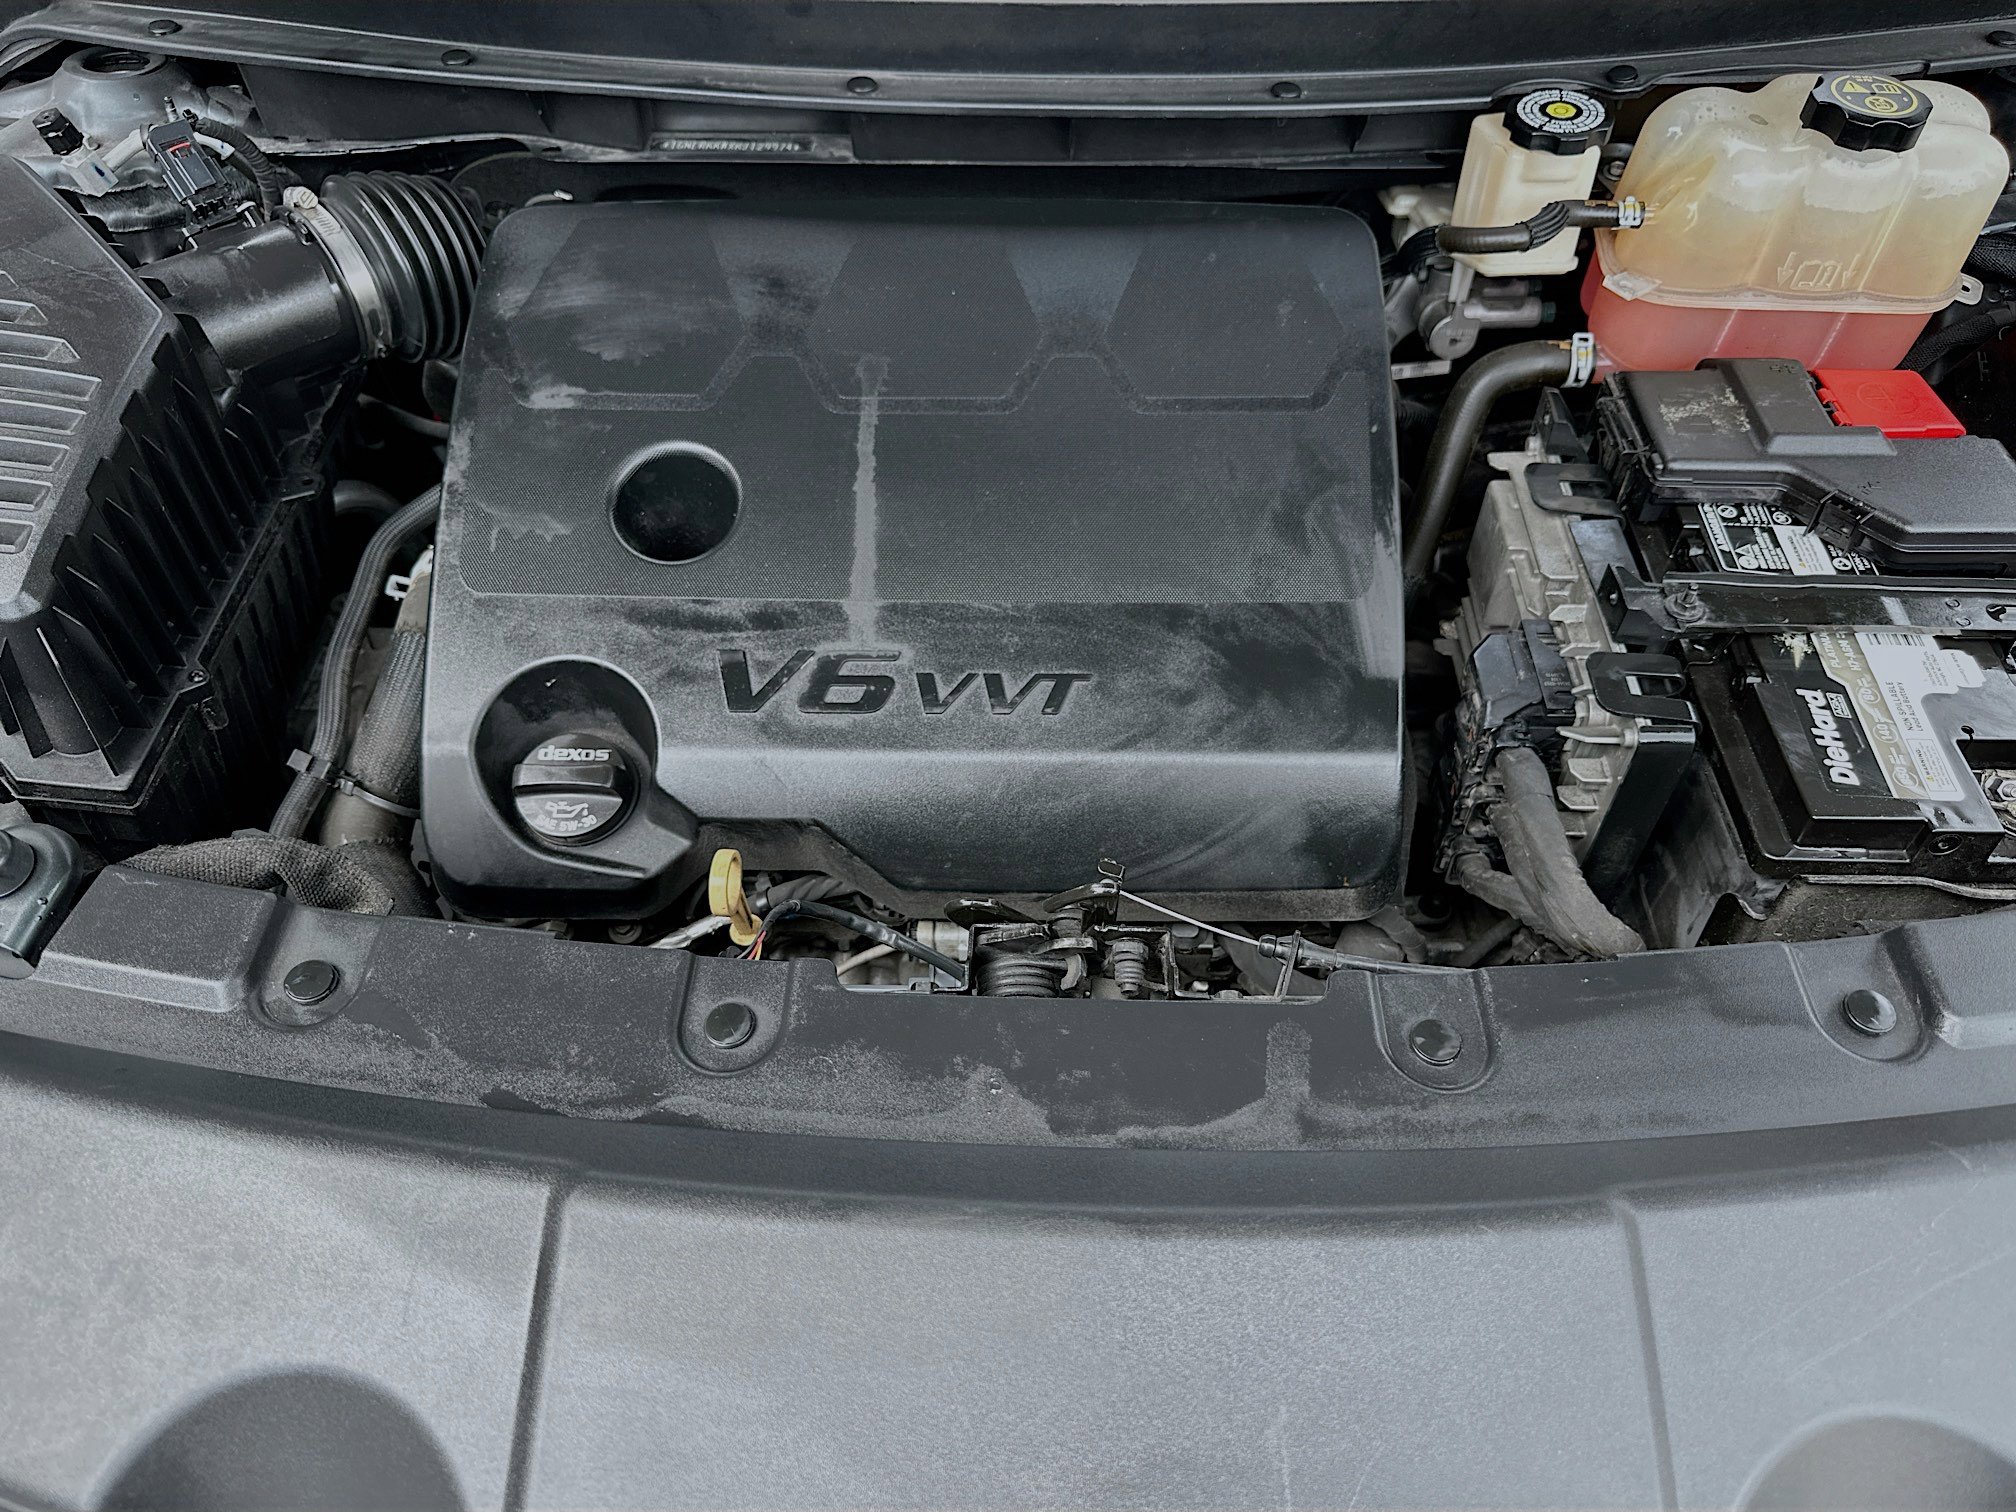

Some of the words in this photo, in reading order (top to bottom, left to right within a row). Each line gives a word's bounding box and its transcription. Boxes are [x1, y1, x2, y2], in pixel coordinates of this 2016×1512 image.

[718, 649, 900, 714] V6
[915, 672, 1094, 716] VVT
[1795, 688, 1861, 786] DieHard
[1876, 723, 1893, 740] 140
[538, 745, 612, 761] dexos
[559, 814, 597, 831] 5W-30
